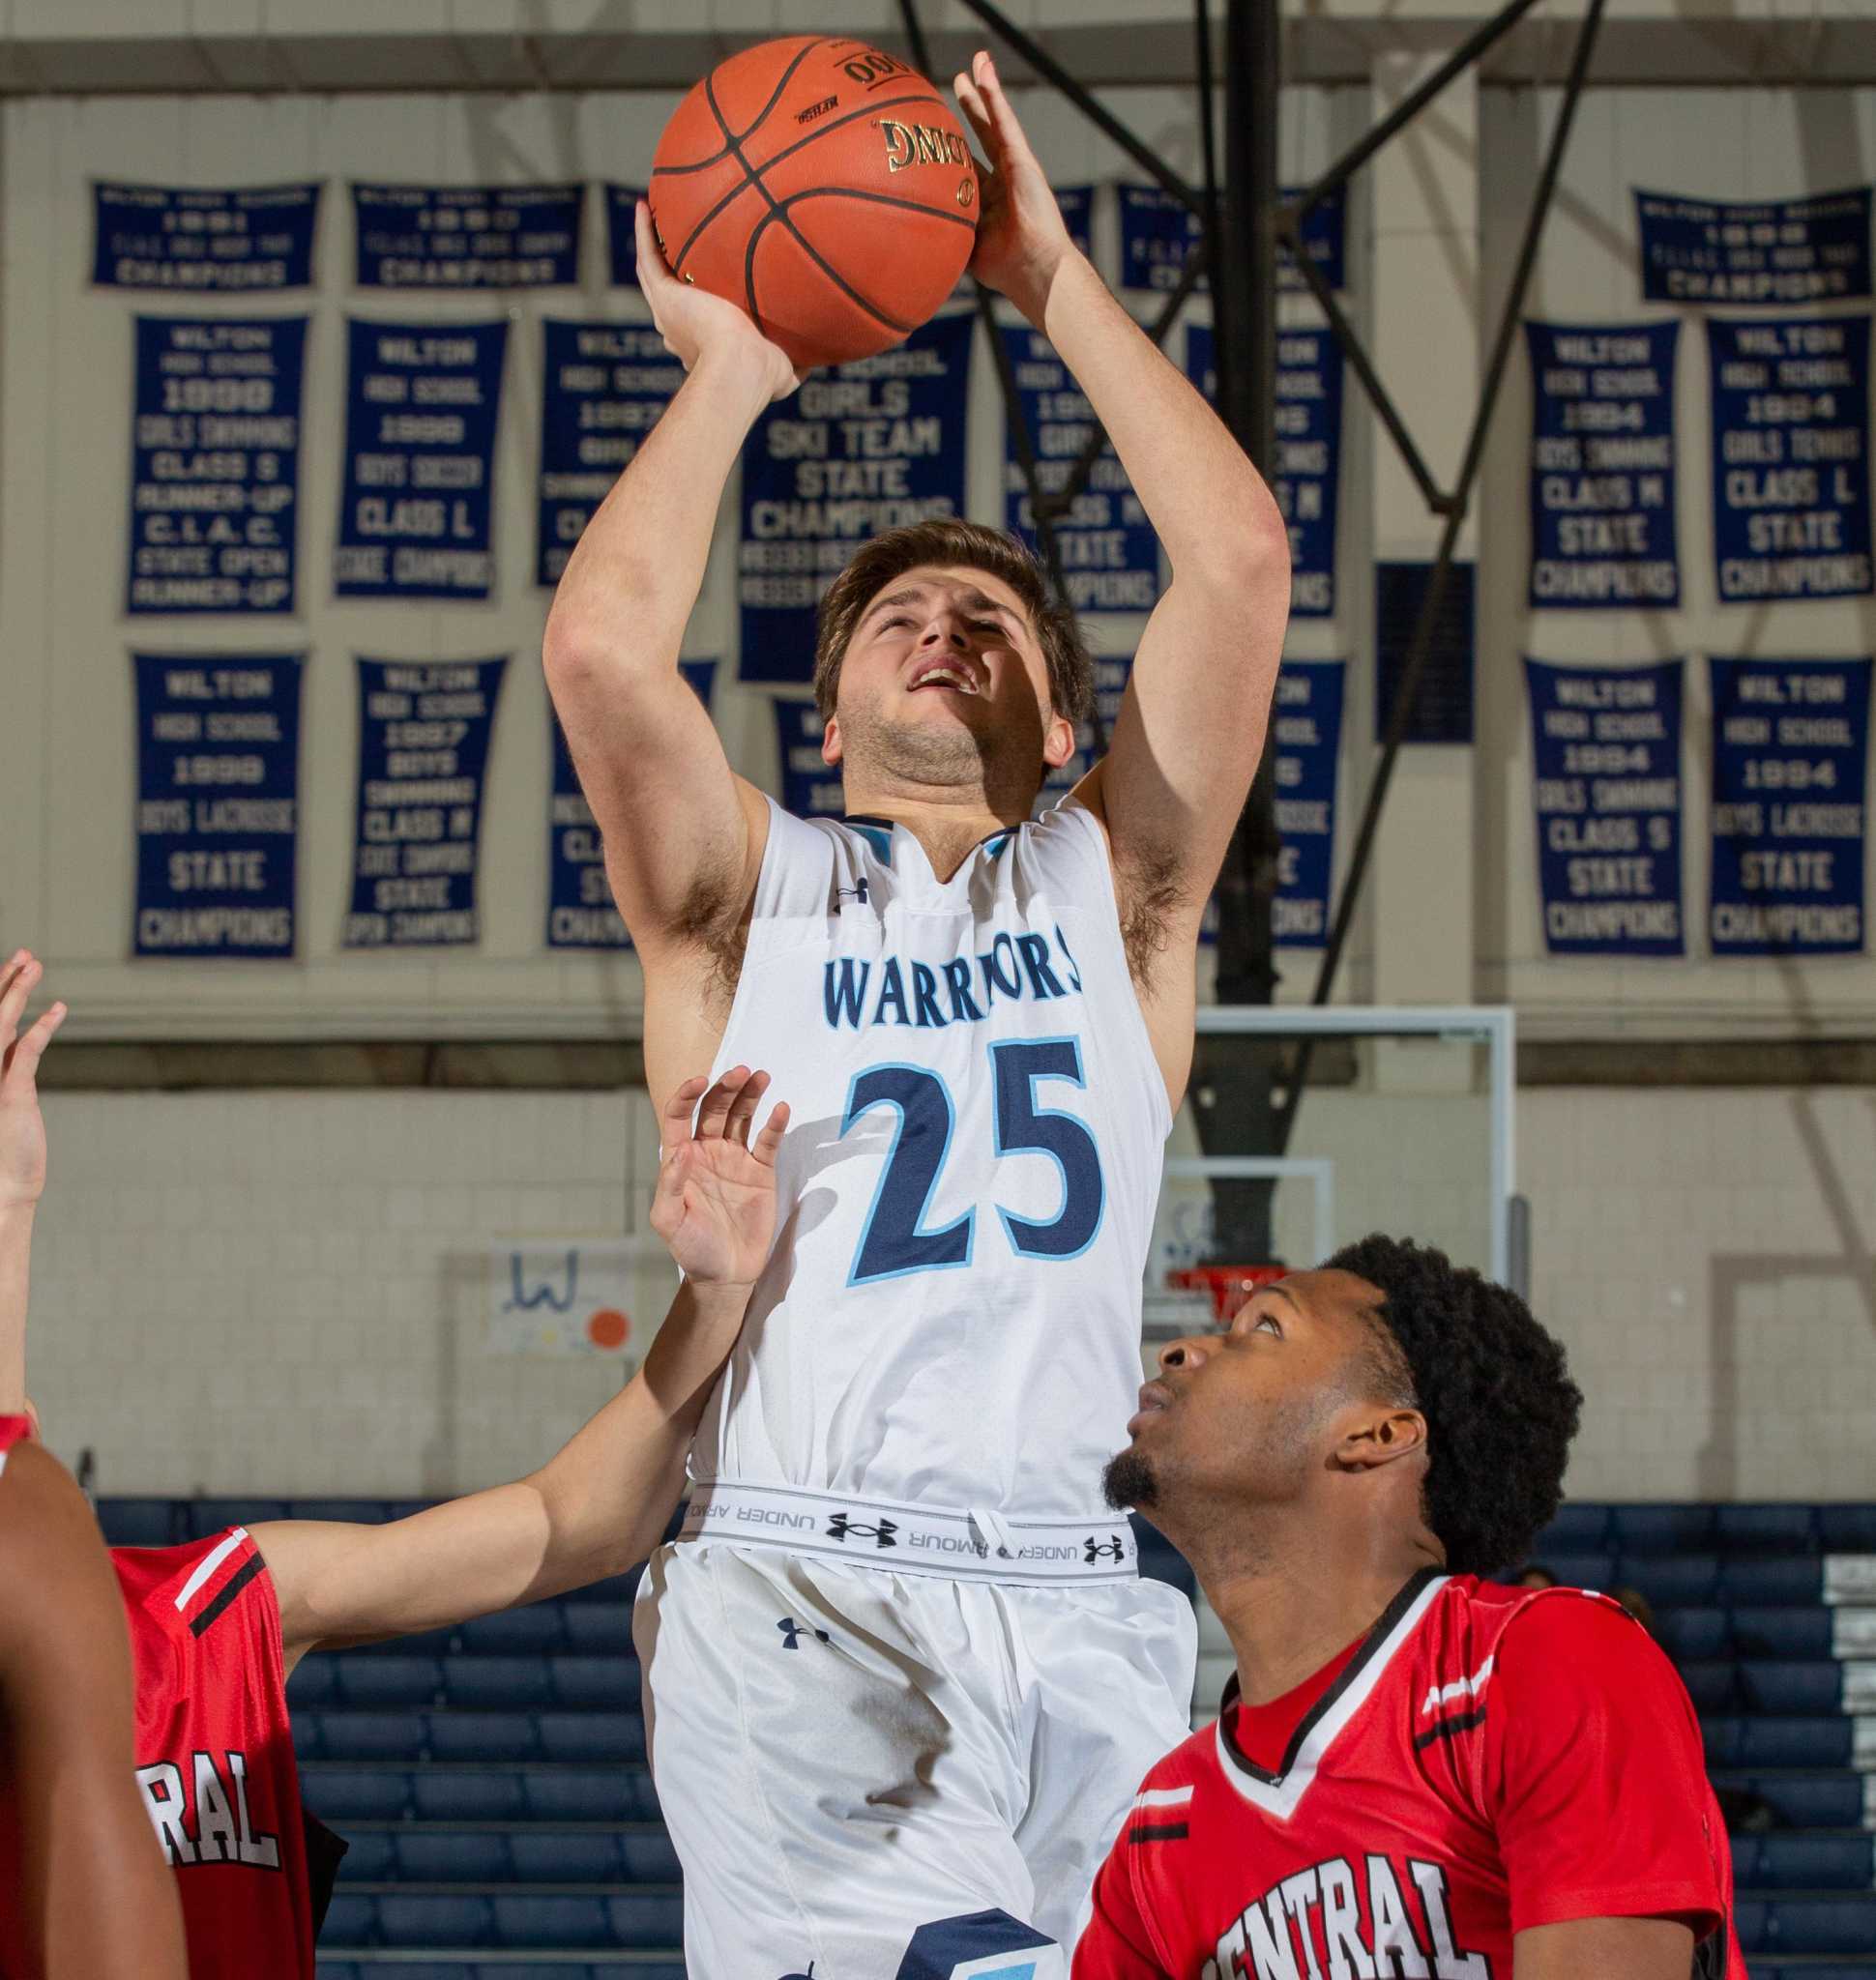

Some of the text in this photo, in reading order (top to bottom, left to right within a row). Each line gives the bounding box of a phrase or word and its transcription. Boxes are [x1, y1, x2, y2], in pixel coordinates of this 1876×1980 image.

[878, 119, 974, 173] DING
[172, 327, 271, 349] WILTON
[379, 339, 476, 364] WILTON
[1555, 337, 1650, 364] WILTON
[1736, 327, 1842, 354] WILTON
[797, 379, 908, 420] GIRLS
[768, 416, 940, 458] SKI TEAM
[152, 452, 247, 480] CLASS
[798, 459, 909, 501] STATE
[1543, 477, 1631, 510] CLASS
[1726, 467, 1854, 507] CLASS L
[357, 499, 473, 538] CLASS L
[1559, 515, 1646, 553] STATE
[1748, 512, 1840, 550] STATE
[1535, 562, 1679, 597] CHAMPIONS
[1721, 556, 1870, 598] CHAMPIONS
[166, 671, 272, 698] WILTON
[385, 663, 478, 690] WILTON
[1556, 681, 1656, 707] WILTON
[1739, 676, 1845, 703] WILTON
[365, 809, 443, 841] CLASS
[1549, 819, 1638, 851] CLASS
[169, 851, 265, 889] STATE
[1568, 858, 1653, 894] STATE
[1743, 852, 1832, 889] STATE
[375, 878, 449, 909] STATE
[139, 909, 290, 946] CHAMPIONS
[1545, 903, 1678, 938] CHAMPIONS
[1712, 905, 1860, 942] CHAMPIONS
[823, 920, 1084, 1032] WARRIORS
[839, 1034, 1106, 1289] 25
